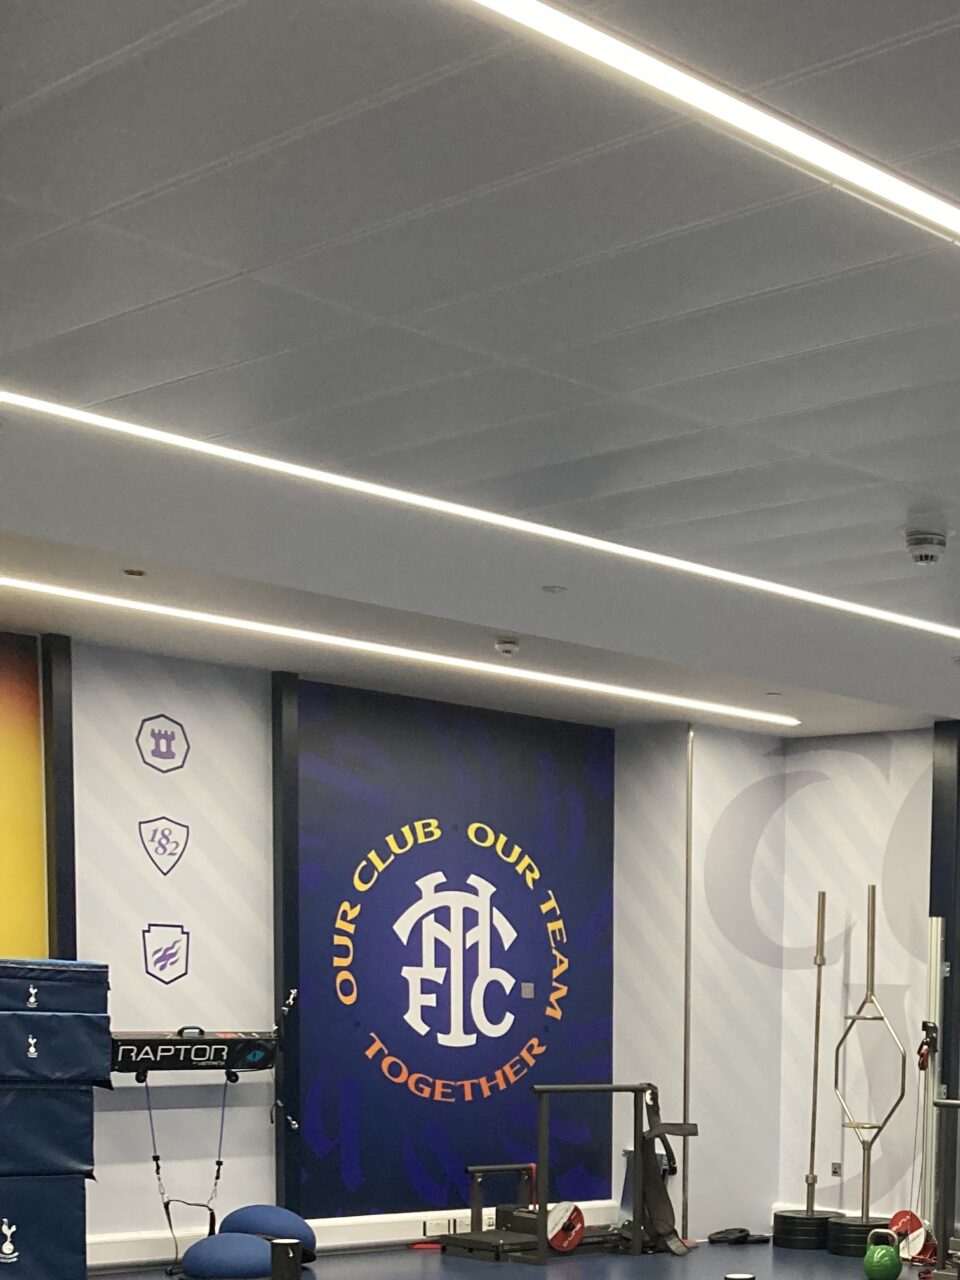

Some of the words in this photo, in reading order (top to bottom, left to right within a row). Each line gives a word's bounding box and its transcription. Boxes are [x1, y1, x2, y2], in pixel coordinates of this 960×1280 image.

[332, 901, 362, 1006] OUR
[353, 818, 443, 892] CLUB
[467, 822, 542, 891] OUR
[539, 890, 570, 1021] TEAM
[118, 1045, 229, 1062] RAPTOR
[364, 1032, 548, 1102] TOGETHER
